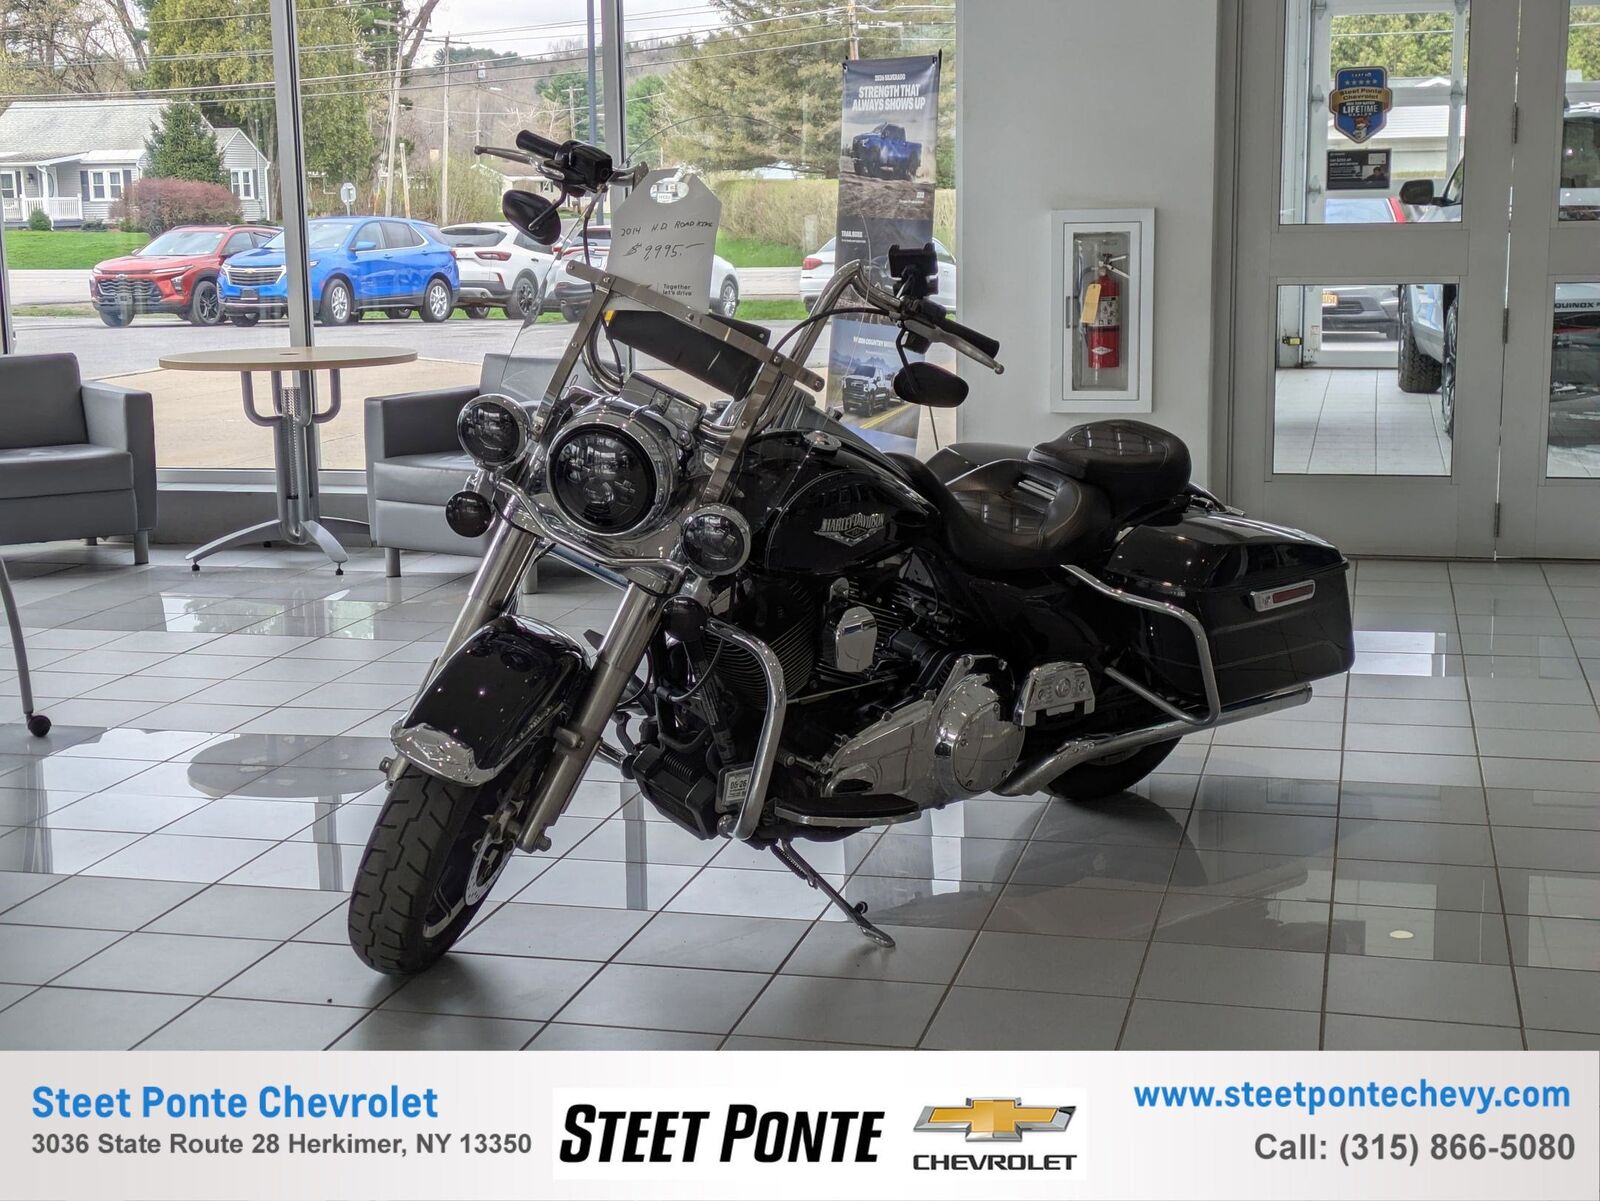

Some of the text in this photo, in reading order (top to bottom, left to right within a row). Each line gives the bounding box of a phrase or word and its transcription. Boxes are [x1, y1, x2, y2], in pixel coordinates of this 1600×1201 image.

[858, 84, 921, 98] STRENGTH THAT
[852, 97, 926, 111] ALWAYS SHOWS UP
[1343, 105, 1379, 113] LIFETIME
[620, 227, 641, 237] 2014
[674, 220, 695, 229] ROAD
[663, 283, 691, 291] Together
